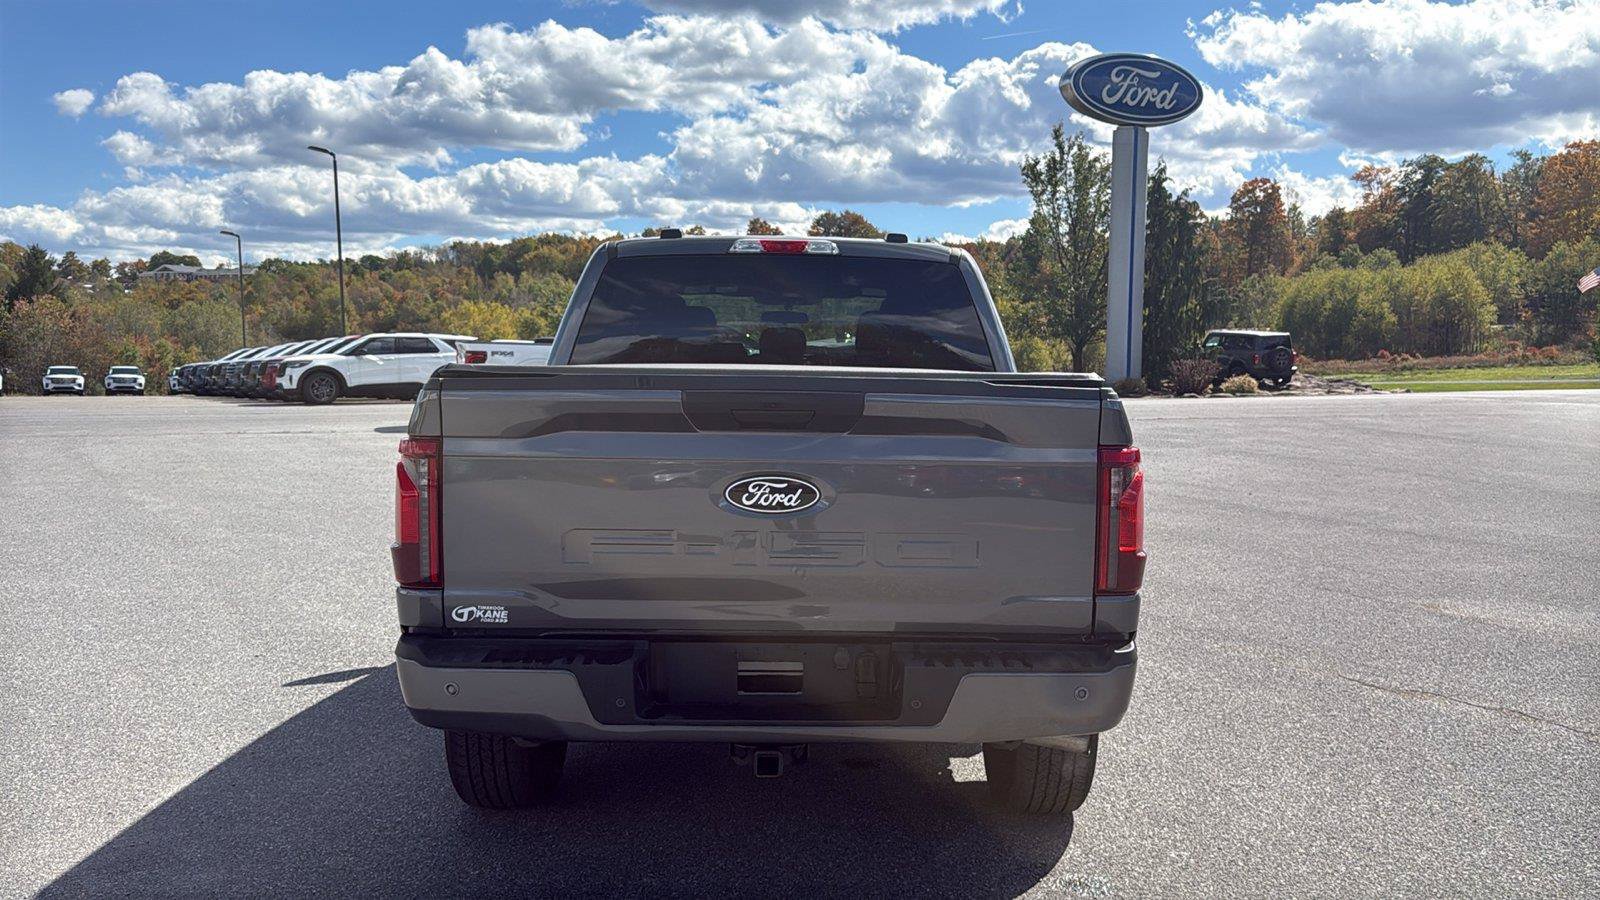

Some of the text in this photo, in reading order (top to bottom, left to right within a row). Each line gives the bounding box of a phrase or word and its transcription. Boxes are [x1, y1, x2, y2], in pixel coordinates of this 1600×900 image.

[1101, 65, 1179, 110] Ford
[742, 481, 802, 507] Ford
[561, 527, 981, 568] F-150
[476, 610, 509, 618] KANE
